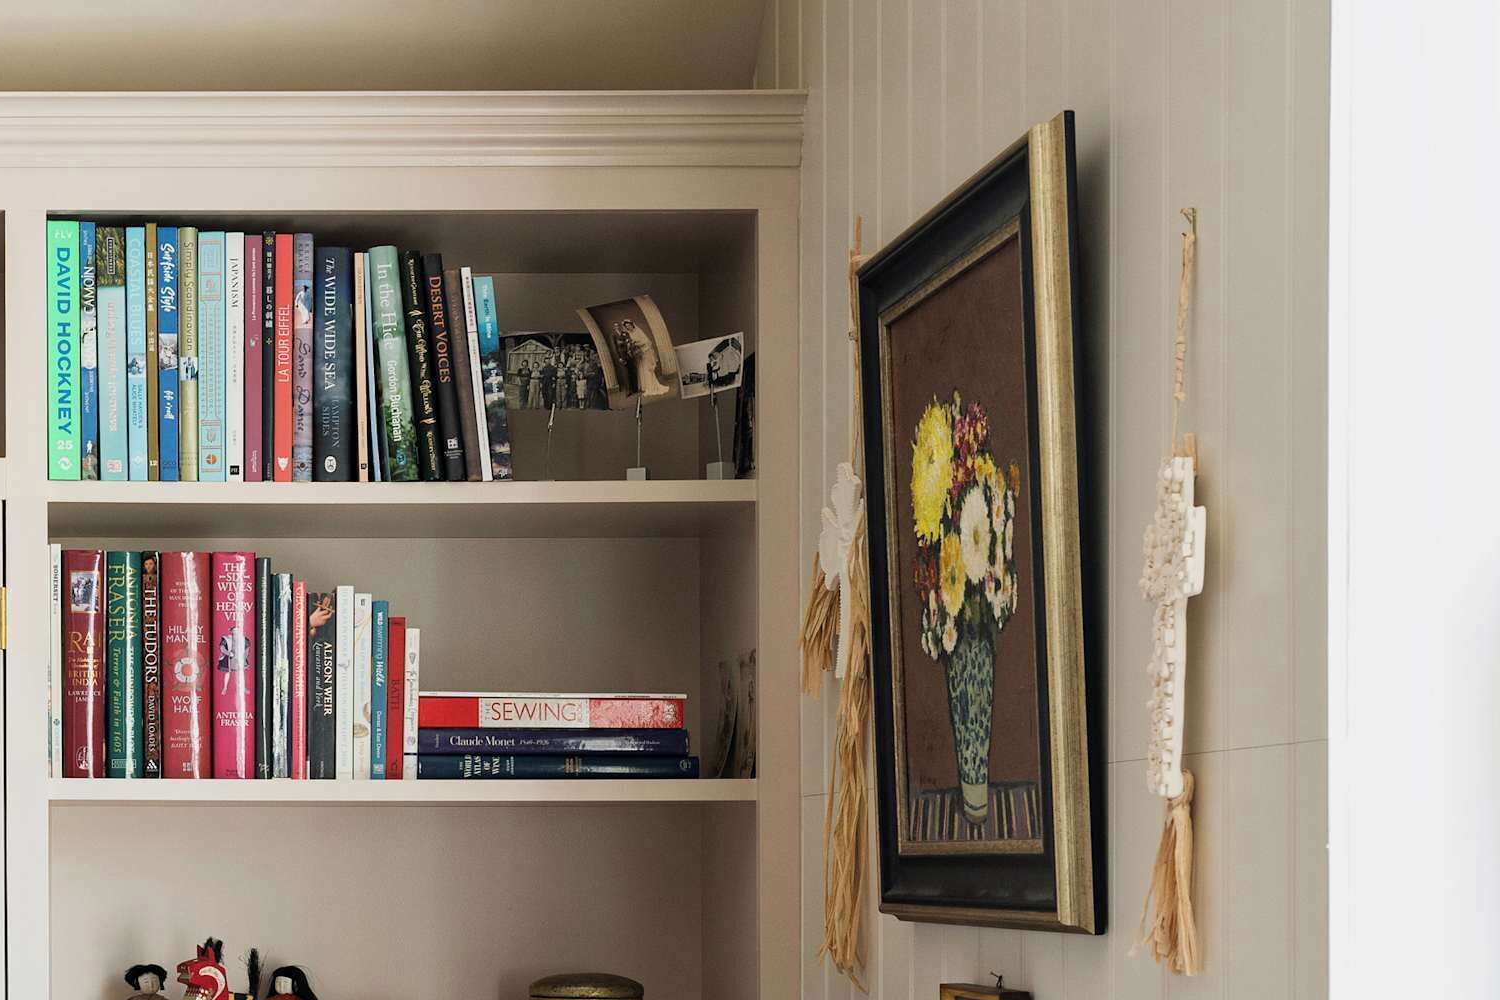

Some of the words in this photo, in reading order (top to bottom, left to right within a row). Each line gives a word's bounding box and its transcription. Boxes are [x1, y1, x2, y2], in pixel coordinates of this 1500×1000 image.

[129, 238, 142, 299] COASTAL
[160, 243, 176, 283] Surfside
[183, 242, 194, 278] Simply
[325, 257, 335, 274] The
[377, 263, 391, 278] In
[57, 247, 71, 314] DAVID
[229, 257, 240, 308] JAPANISM
[324, 276, 337, 316] WIDE
[378, 283, 393, 308] the
[161, 286, 178, 313] Style
[429, 276, 446, 328] DESERT
[129, 304, 142, 345] BLUES
[184, 282, 197, 352] Scandinavian
[278, 304, 290, 336] EIFFEL
[381, 312, 398, 349] Hide
[278, 339, 290, 367] TOUR
[324, 320, 337, 360] WIDE
[296, 338, 311, 378] Sand
[435, 331, 452, 383] VOICES
[57, 321, 73, 435] HOCKNEY
[278, 370, 290, 383] LA
[324, 362, 337, 390] SEA
[387, 360, 398, 392] Gordon
[297, 386, 312, 431] Dance
[419, 379, 433, 414] WILLOWS
[322, 406, 331, 437] SIDES
[331, 396, 340, 448] HAMPTON
[389, 394, 403, 442] Buchanan
[56, 440, 71, 454] 25
[109, 564, 126, 644] FRASER
[144, 587, 157, 619] THE
[295, 587, 304, 645] GEORGIAN
[113, 647, 122, 676] Terror
[144, 620, 157, 683] TUDORS
[312, 642, 324, 674] Lancaster
[323, 642, 333, 683] ALISON
[295, 648, 304, 698] SUMMER
[315, 676, 323, 690] and
[375, 661, 385, 687] Walks
[113, 691, 122, 714] Faith
[147, 695, 155, 720] DAVID
[313, 692, 324, 712] York
[323, 686, 333, 716] WEIR
[390, 680, 400, 711] BATH
[491, 702, 577, 721] SEWING
[113, 718, 122, 727] in
[148, 722, 156, 752] LOADES
[113, 731, 122, 753] 1605
[449, 735, 483, 747] Claude
[484, 735, 515, 747] Monet
[463, 754, 473, 778] WORLD
[473, 755, 482, 776] ATLAS
[483, 760, 491, 771] OF
[492, 756, 500, 775] WINE
